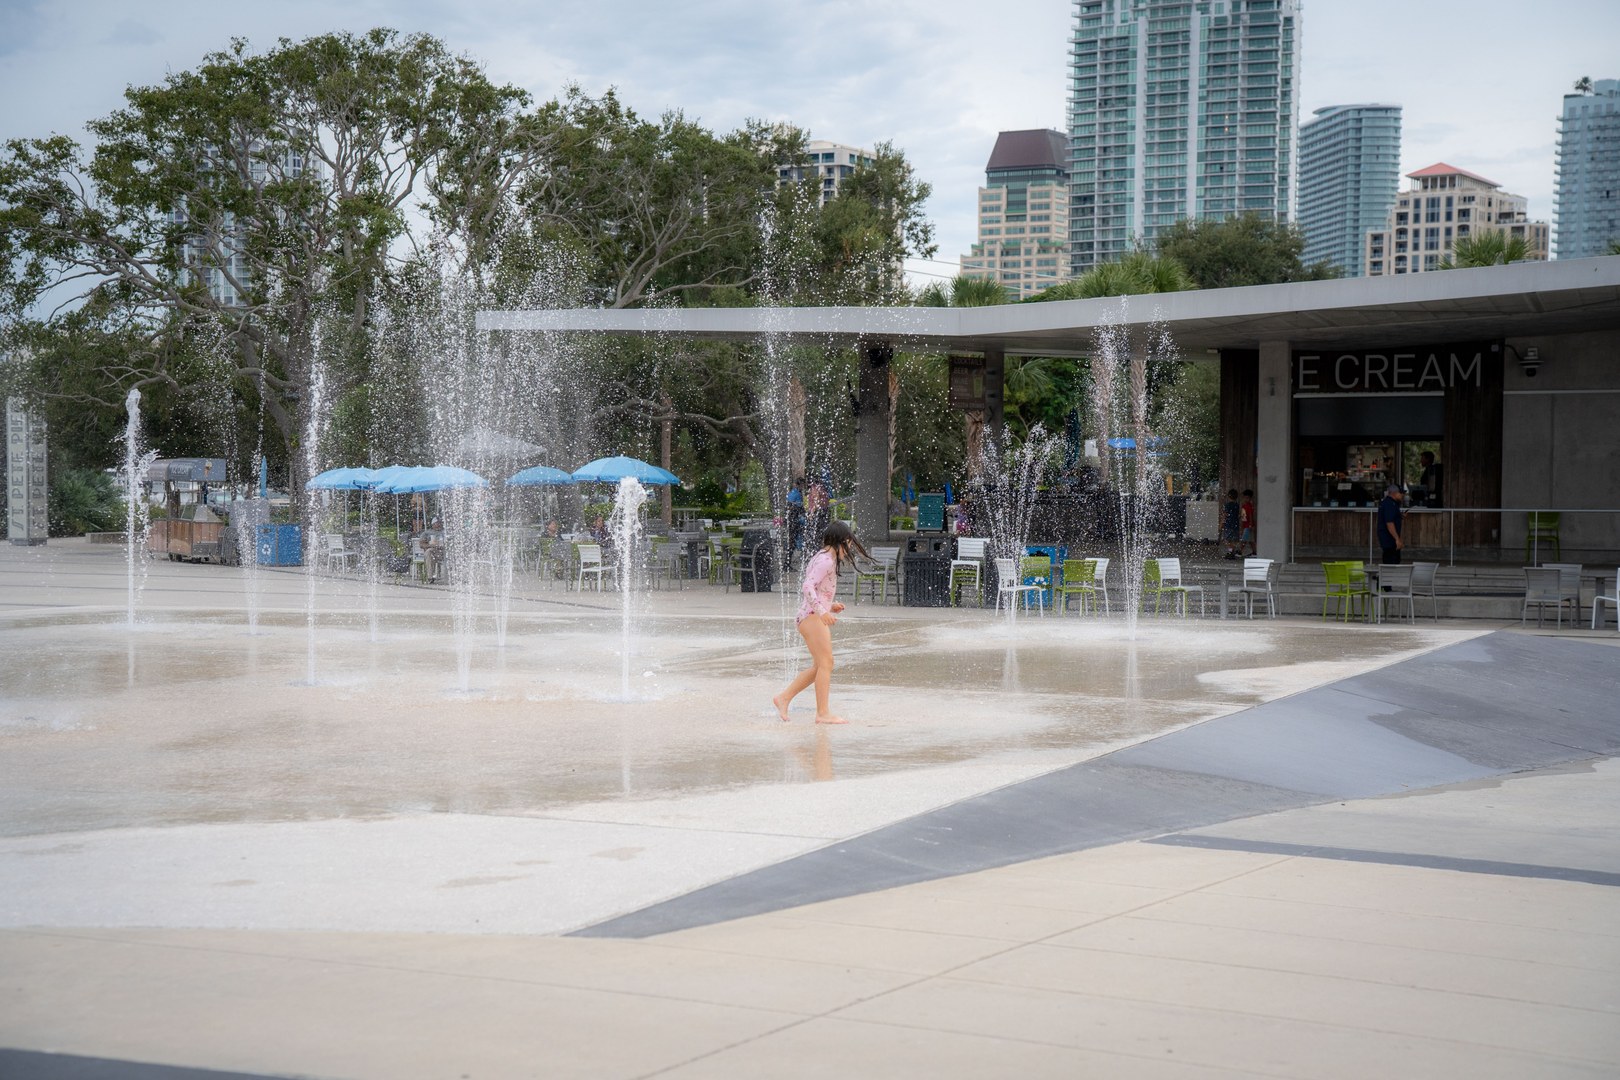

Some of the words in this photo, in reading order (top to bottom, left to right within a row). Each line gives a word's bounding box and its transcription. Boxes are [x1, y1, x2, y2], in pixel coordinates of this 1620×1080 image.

[1291, 355, 1320, 389] E
[1335, 352, 1481, 389] CREAM
[11, 451, 24, 499] PETE
[32, 452, 45, 499] PETE
